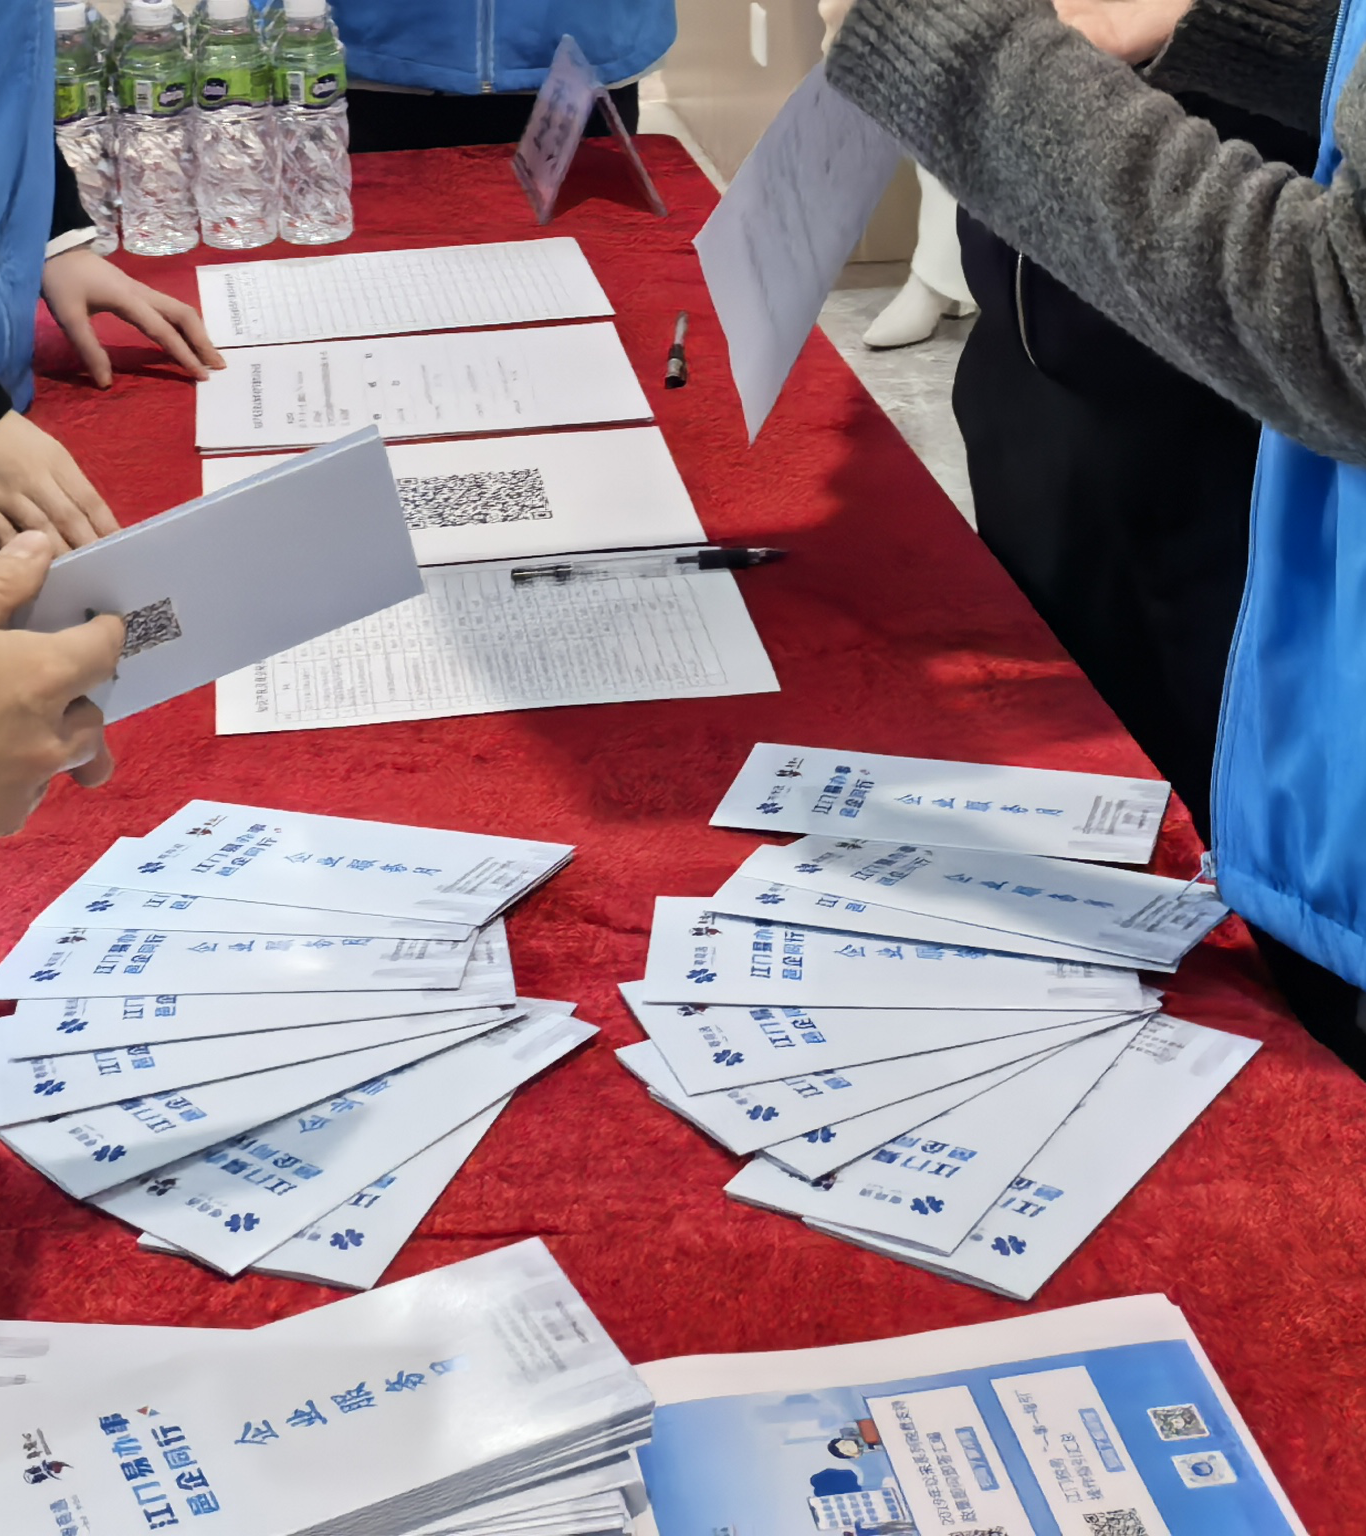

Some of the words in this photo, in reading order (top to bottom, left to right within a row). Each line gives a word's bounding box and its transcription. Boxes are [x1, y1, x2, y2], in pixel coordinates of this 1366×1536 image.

[283, 851, 443, 877] 企业服务月
[234, 1354, 469, 1445] 企业服务月
[98, 1411, 179, 1530] 江门易办事
[151, 1424, 221, 1517] 邑企同行
